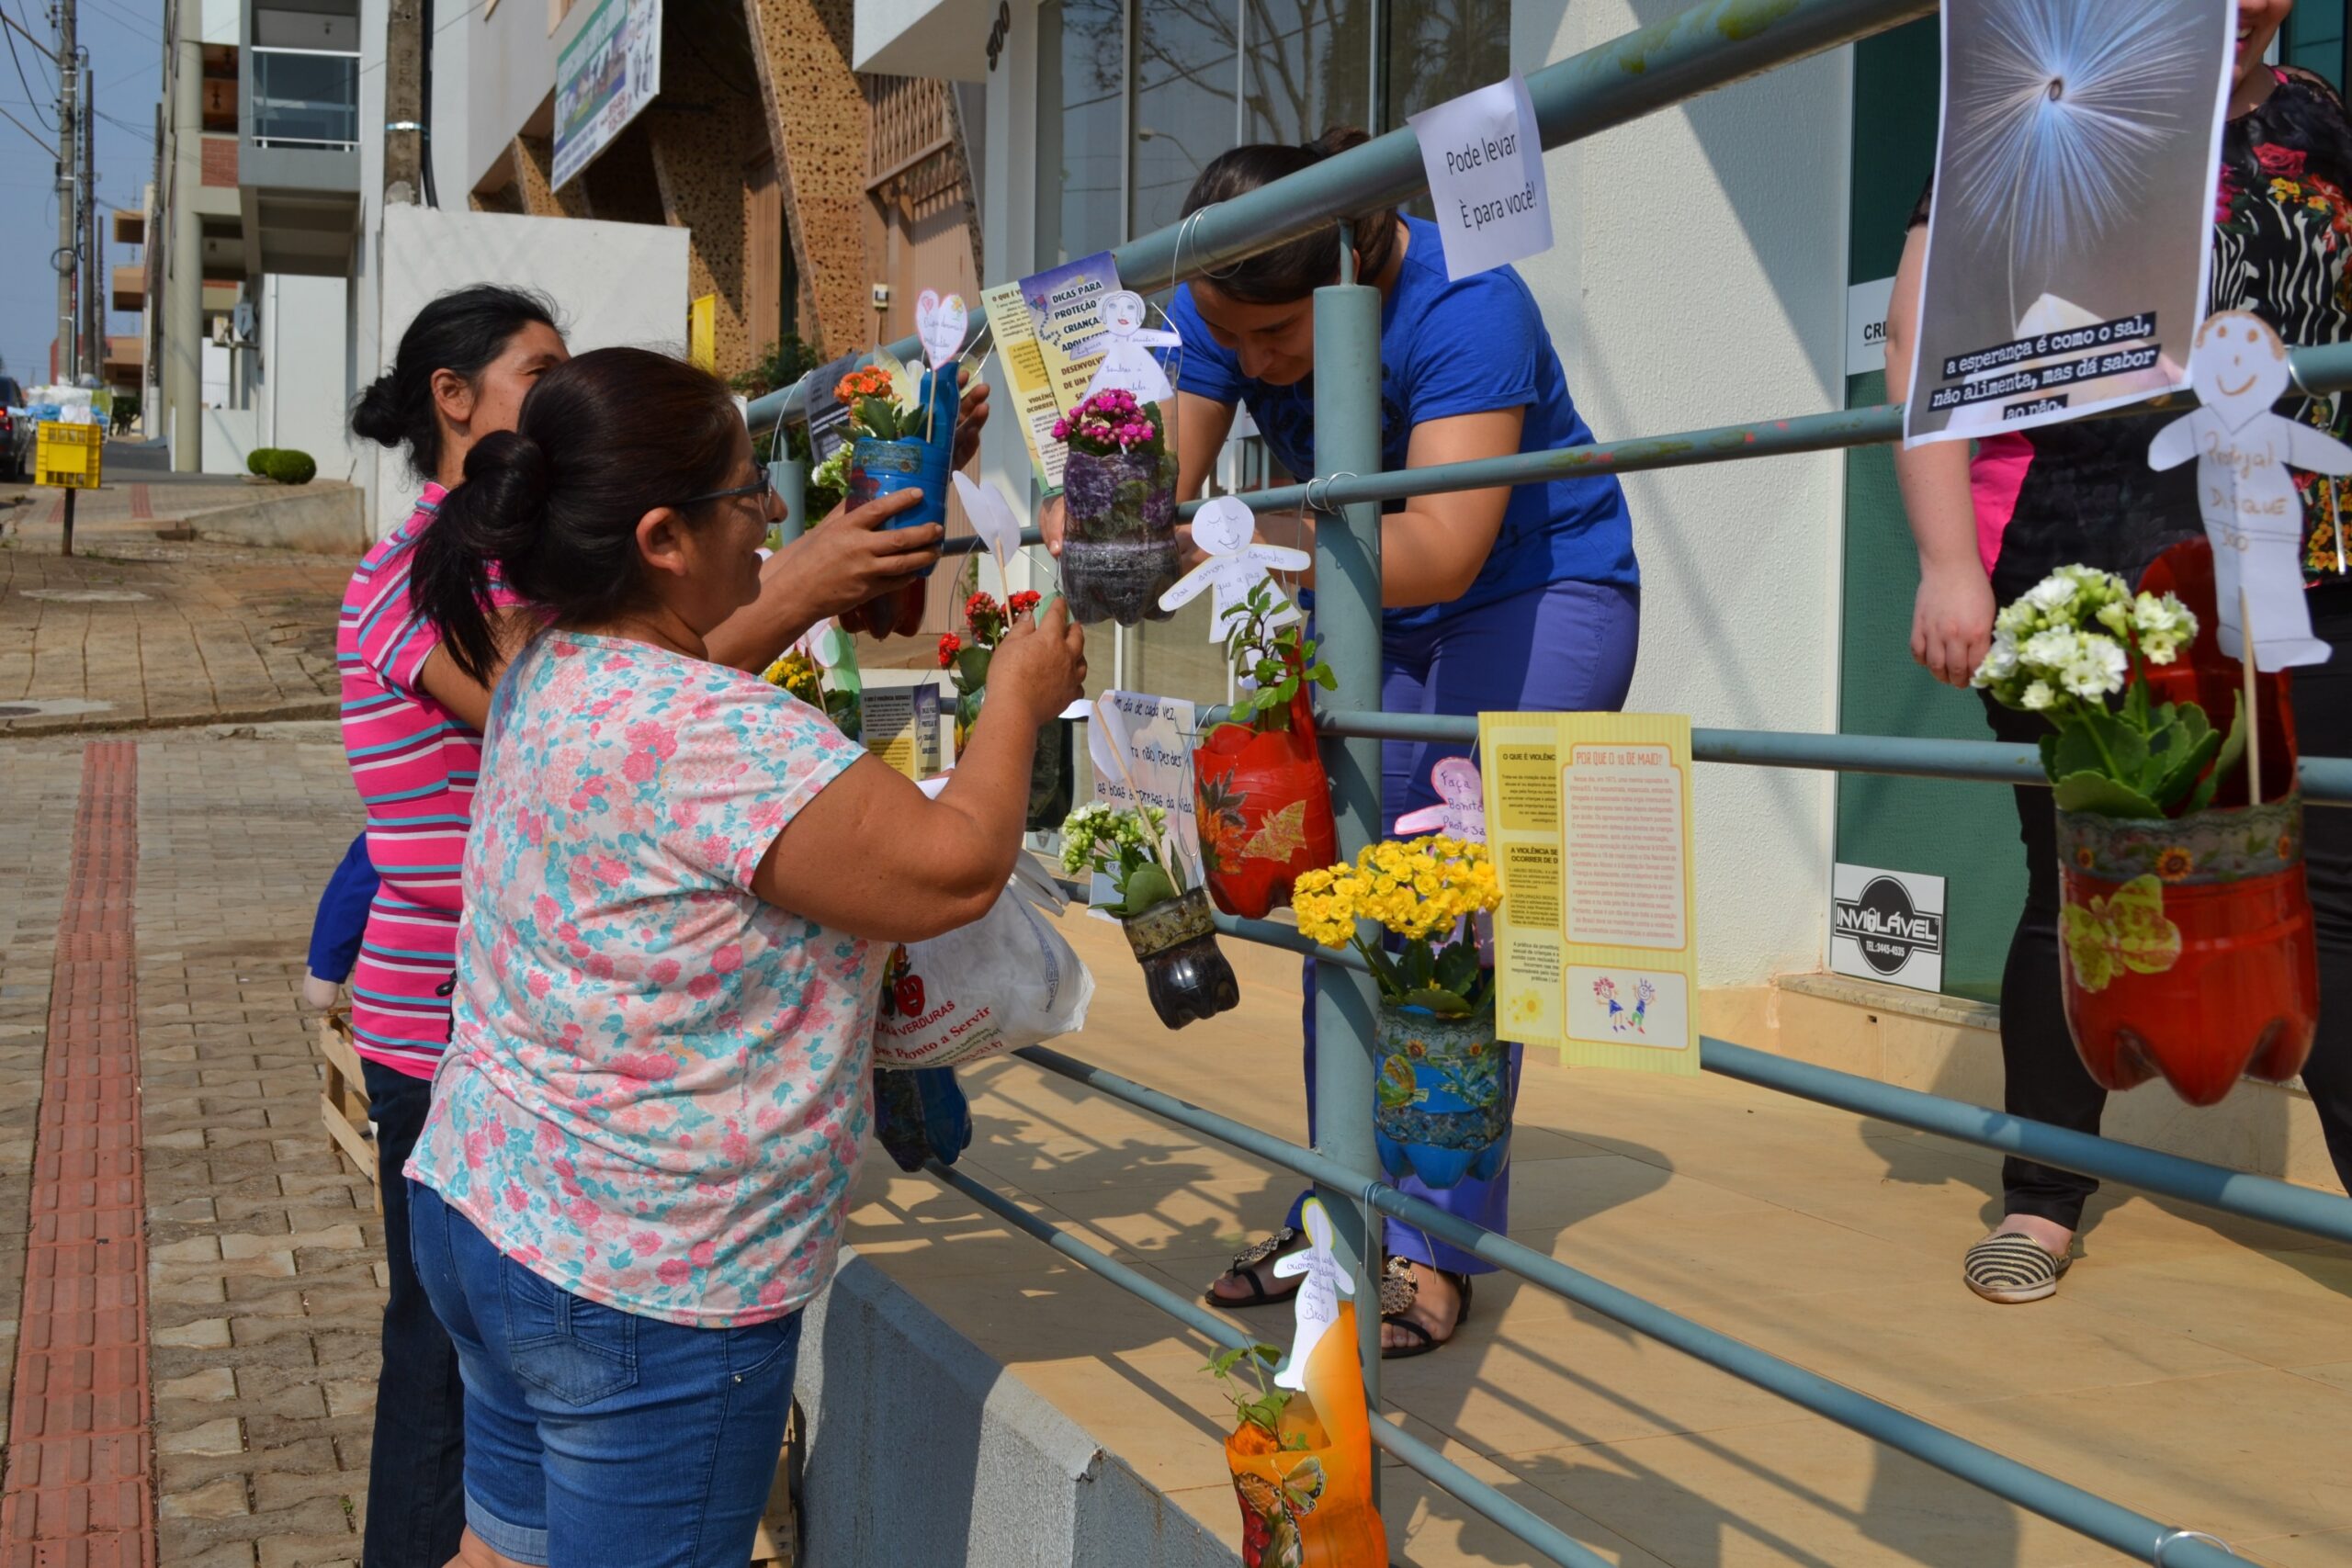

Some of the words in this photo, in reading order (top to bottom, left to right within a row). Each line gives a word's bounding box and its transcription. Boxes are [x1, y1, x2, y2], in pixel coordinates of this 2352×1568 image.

[1446, 143, 1482, 175] Pode
[1481, 134, 1517, 163] levar
[1473, 199, 1505, 231] para
[1505, 181, 1537, 215] você!
[1052, 288, 1077, 304] DICAS
[1078, 281, 1102, 296] PARA
[1054, 299, 1096, 320] PROTEÇÃO
[1063, 317, 1101, 334] CRIANÇA
[1946, 360, 1956, 374] a
[1958, 345, 2032, 374] esperança
[2036, 335, 2047, 352] é
[2051, 330, 2095, 351] como
[2098, 327, 2110, 341] o
[2114, 315, 2151, 339] sal,
[1064, 381, 1073, 389] DE
[1074, 378, 1087, 388] UM
[1932, 389, 1960, 407] não
[1963, 372, 2038, 401] alimenta,
[2042, 366, 2073, 384] mas
[2076, 357, 2098, 377] dá
[2101, 348, 2155, 373] sabor
[1026, 400, 1054, 413] OCORRER
[1124, 698, 1133, 713] dia
[1135, 702, 1142, 716] de
[1145, 705, 1159, 718] cada
[1142, 746, 1156, 761] não
[1158, 750, 1182, 767] perder
[1577, 751, 1591, 764] POR
[1593, 751, 1607, 765] QUE
[1609, 751, 1614, 764] O
[1626, 751, 1635, 765] DE
[1637, 752, 1663, 765] MAIO?
[1441, 771, 1471, 793] Faça
[1097, 783, 1105, 795] as
[1109, 781, 1125, 799] boas
[1167, 794, 1175, 809] da
[1448, 797, 1484, 812] Bonito
[1511, 855, 1543, 863] OCORRER
[1516, 847, 1549, 855] VIOLÊNCIA
[899, 1000, 956, 1035] VERDURAS
[896, 1040, 938, 1060] Pronto
[940, 1035, 949, 1044] a
[949, 1006, 990, 1038] Servir
